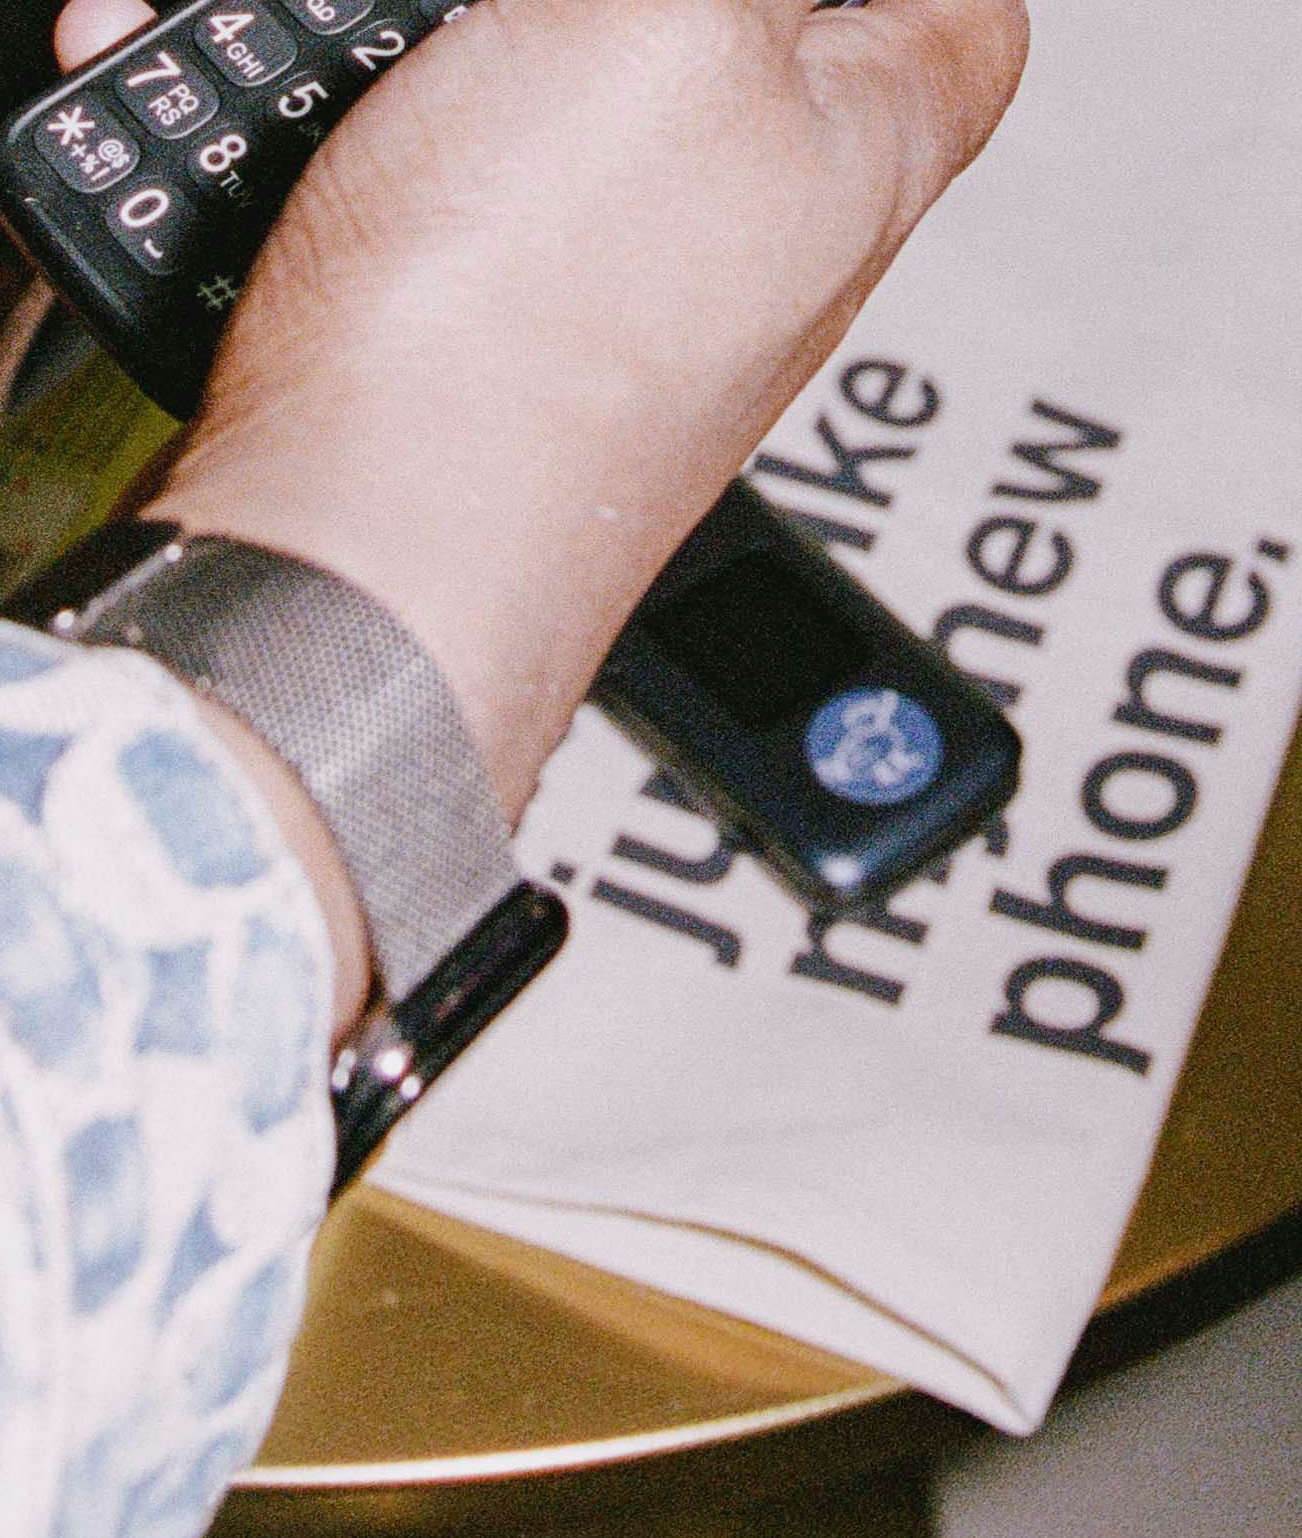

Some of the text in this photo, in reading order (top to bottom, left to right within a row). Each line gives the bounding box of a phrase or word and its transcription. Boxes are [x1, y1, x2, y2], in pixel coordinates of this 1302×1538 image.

[209, 13, 265, 79] 4 GHI
[350, 29, 406, 71] 2
[126, 51, 200, 115] 7 PQ
[277, 80, 331, 119] 5
[148, 94, 182, 126] RS
[199, 134, 248, 174] 8
[119, 187, 170, 229] 0
[197, 274, 241, 312] #
[923, 398, 1123, 706] new
[987, 534, 1293, 1076] phone.
[549, 760, 745, 969] ju
